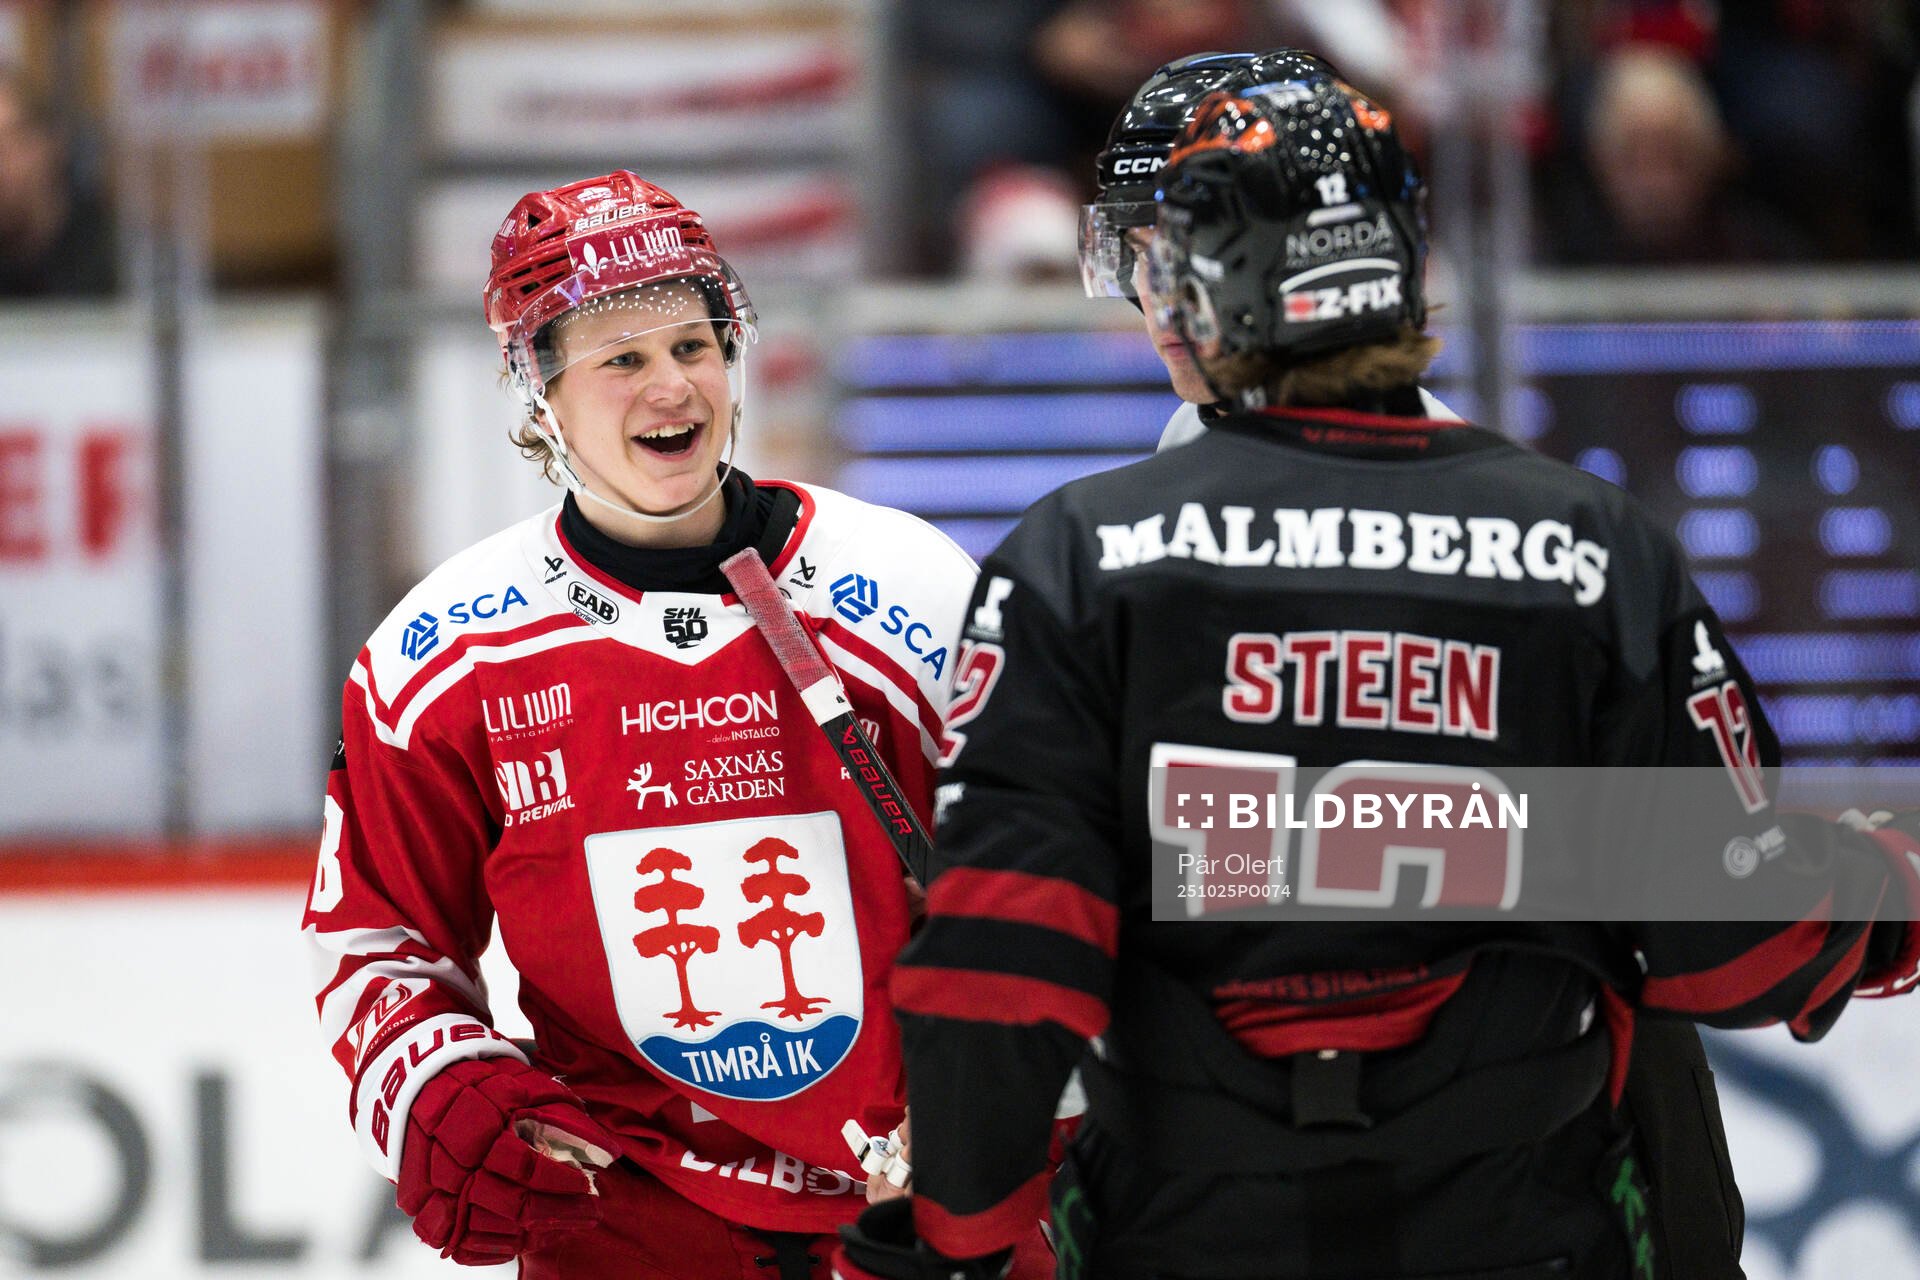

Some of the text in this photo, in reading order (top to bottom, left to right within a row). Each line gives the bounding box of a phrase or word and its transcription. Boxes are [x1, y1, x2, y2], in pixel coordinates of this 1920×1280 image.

[609, 226, 684, 266] LILIUM
[1097, 502, 1609, 606] MALMBERGS
[448, 585, 528, 624] SCA
[571, 585, 614, 621] EAB
[663, 608, 706, 619] SHL
[663, 619, 708, 643] 50
[880, 605, 948, 681] SCA
[1222, 630, 1501, 741] STEEN
[482, 682, 572, 733] LILIUM
[621, 690, 778, 736] HIGHCON
[490, 718, 574, 743] FASTIGHETER
[731, 726, 780, 741] INSTALCO
[684, 750, 784, 781] SAXNÄS
[520, 795, 576, 825] RENTAL
[686, 777, 785, 805] GÅRDEN
[849, 748, 912, 835] BAUER
[682, 1032, 822, 1082] TIMRÅ IK
